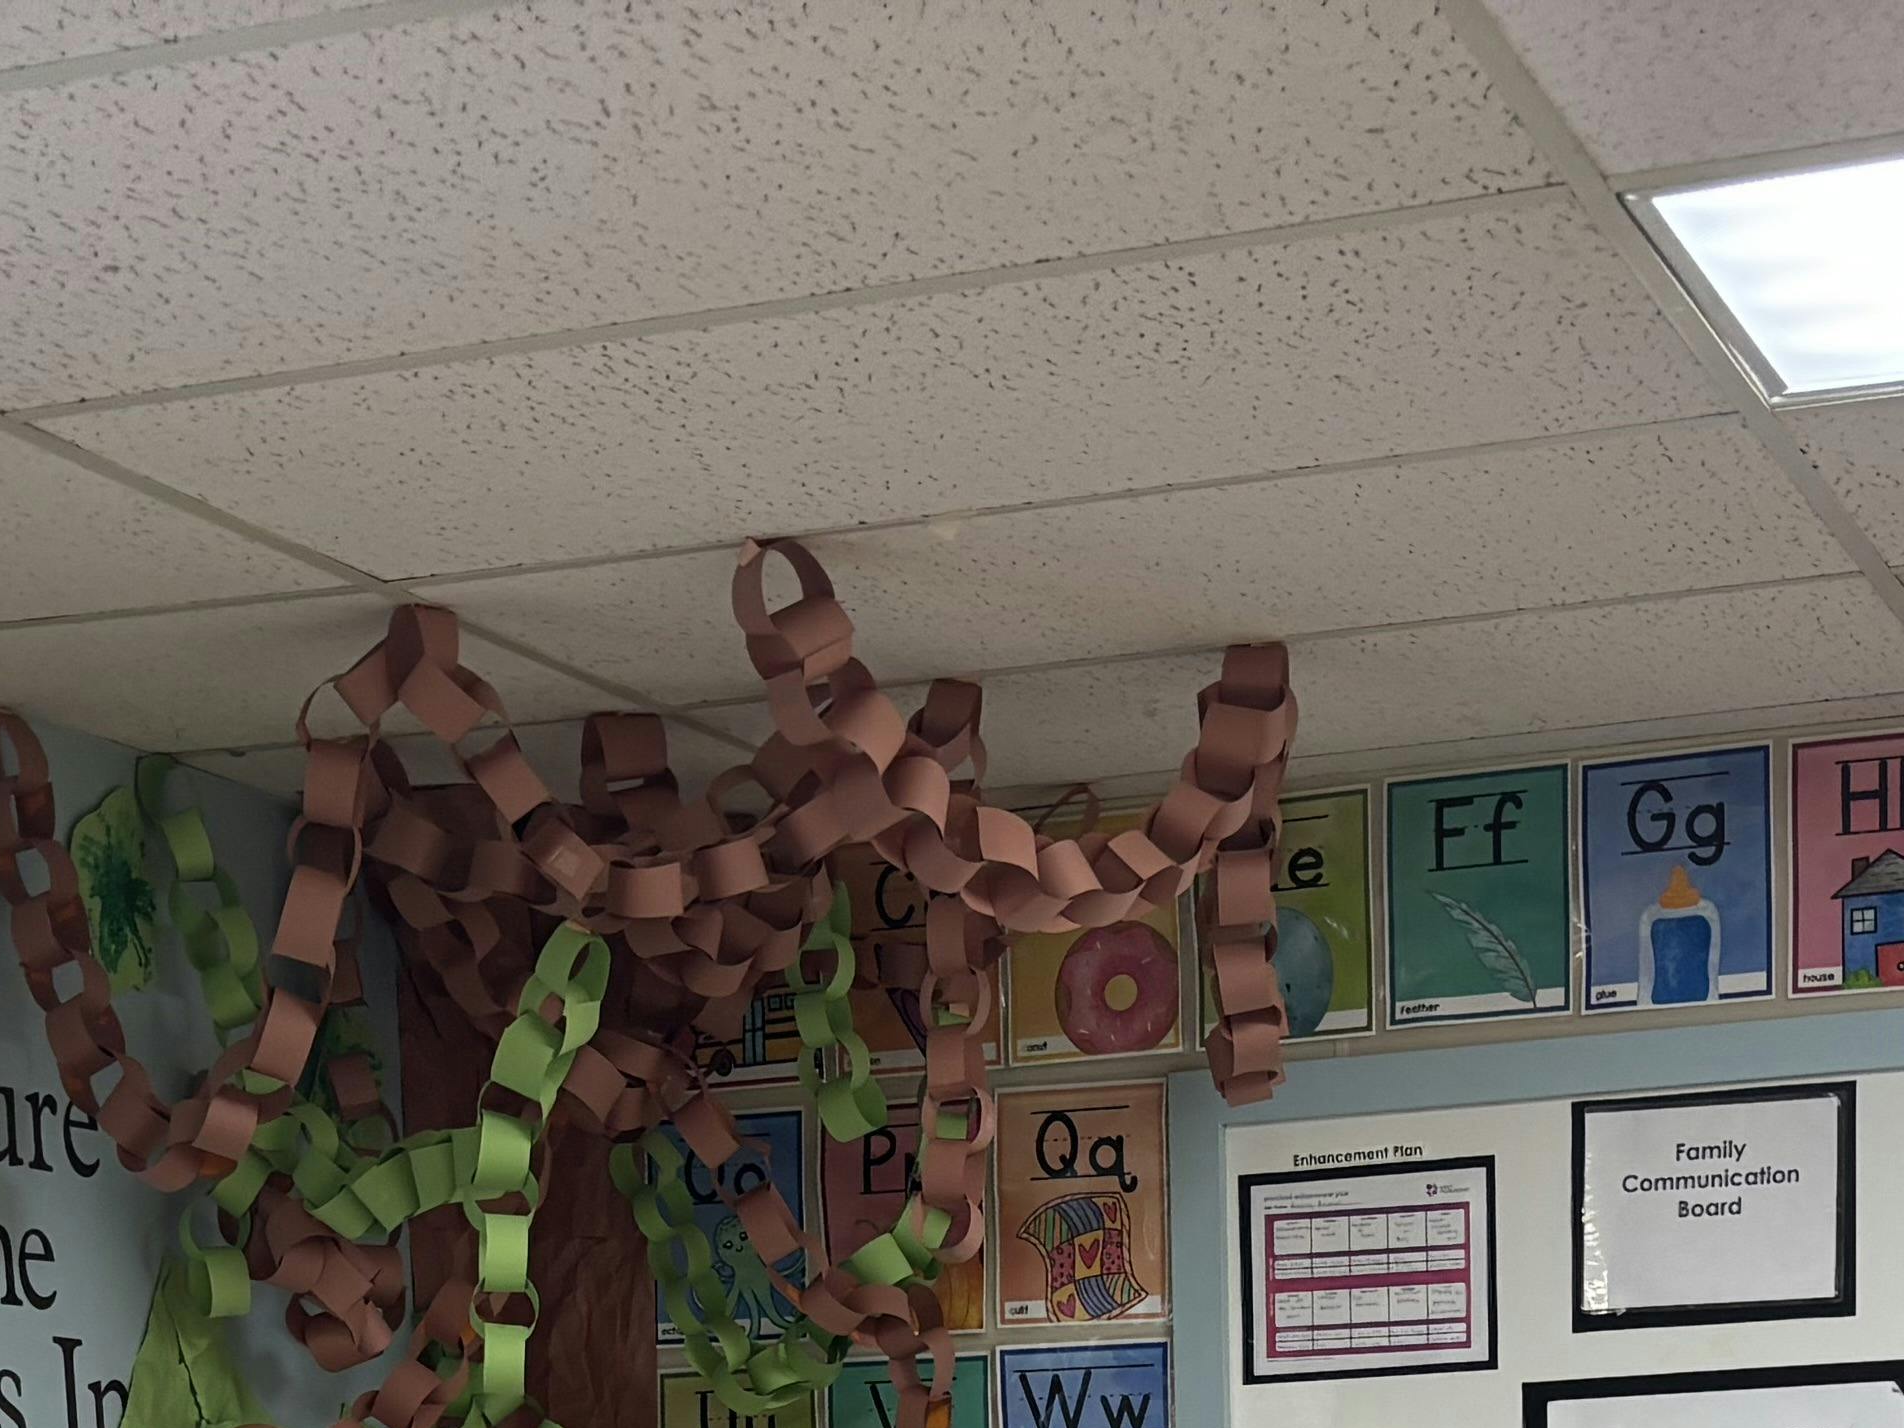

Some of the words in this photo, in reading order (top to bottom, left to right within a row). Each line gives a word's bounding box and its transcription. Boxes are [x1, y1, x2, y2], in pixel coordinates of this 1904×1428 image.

[1434, 790, 1525, 872] Ff
[1627, 781, 1726, 866] Gg
[1802, 970, 1836, 985] house
[1399, 1000, 1441, 1017] feather
[1036, 1111, 1138, 1194] Qq
[1292, 1145, 1389, 1168] Enhancement
[1392, 1144, 1423, 1159] Plan
[1675, 1139, 1747, 1162] Family
[1621, 1165, 1801, 1194] Communication
[1677, 1196, 1743, 1218] Board
